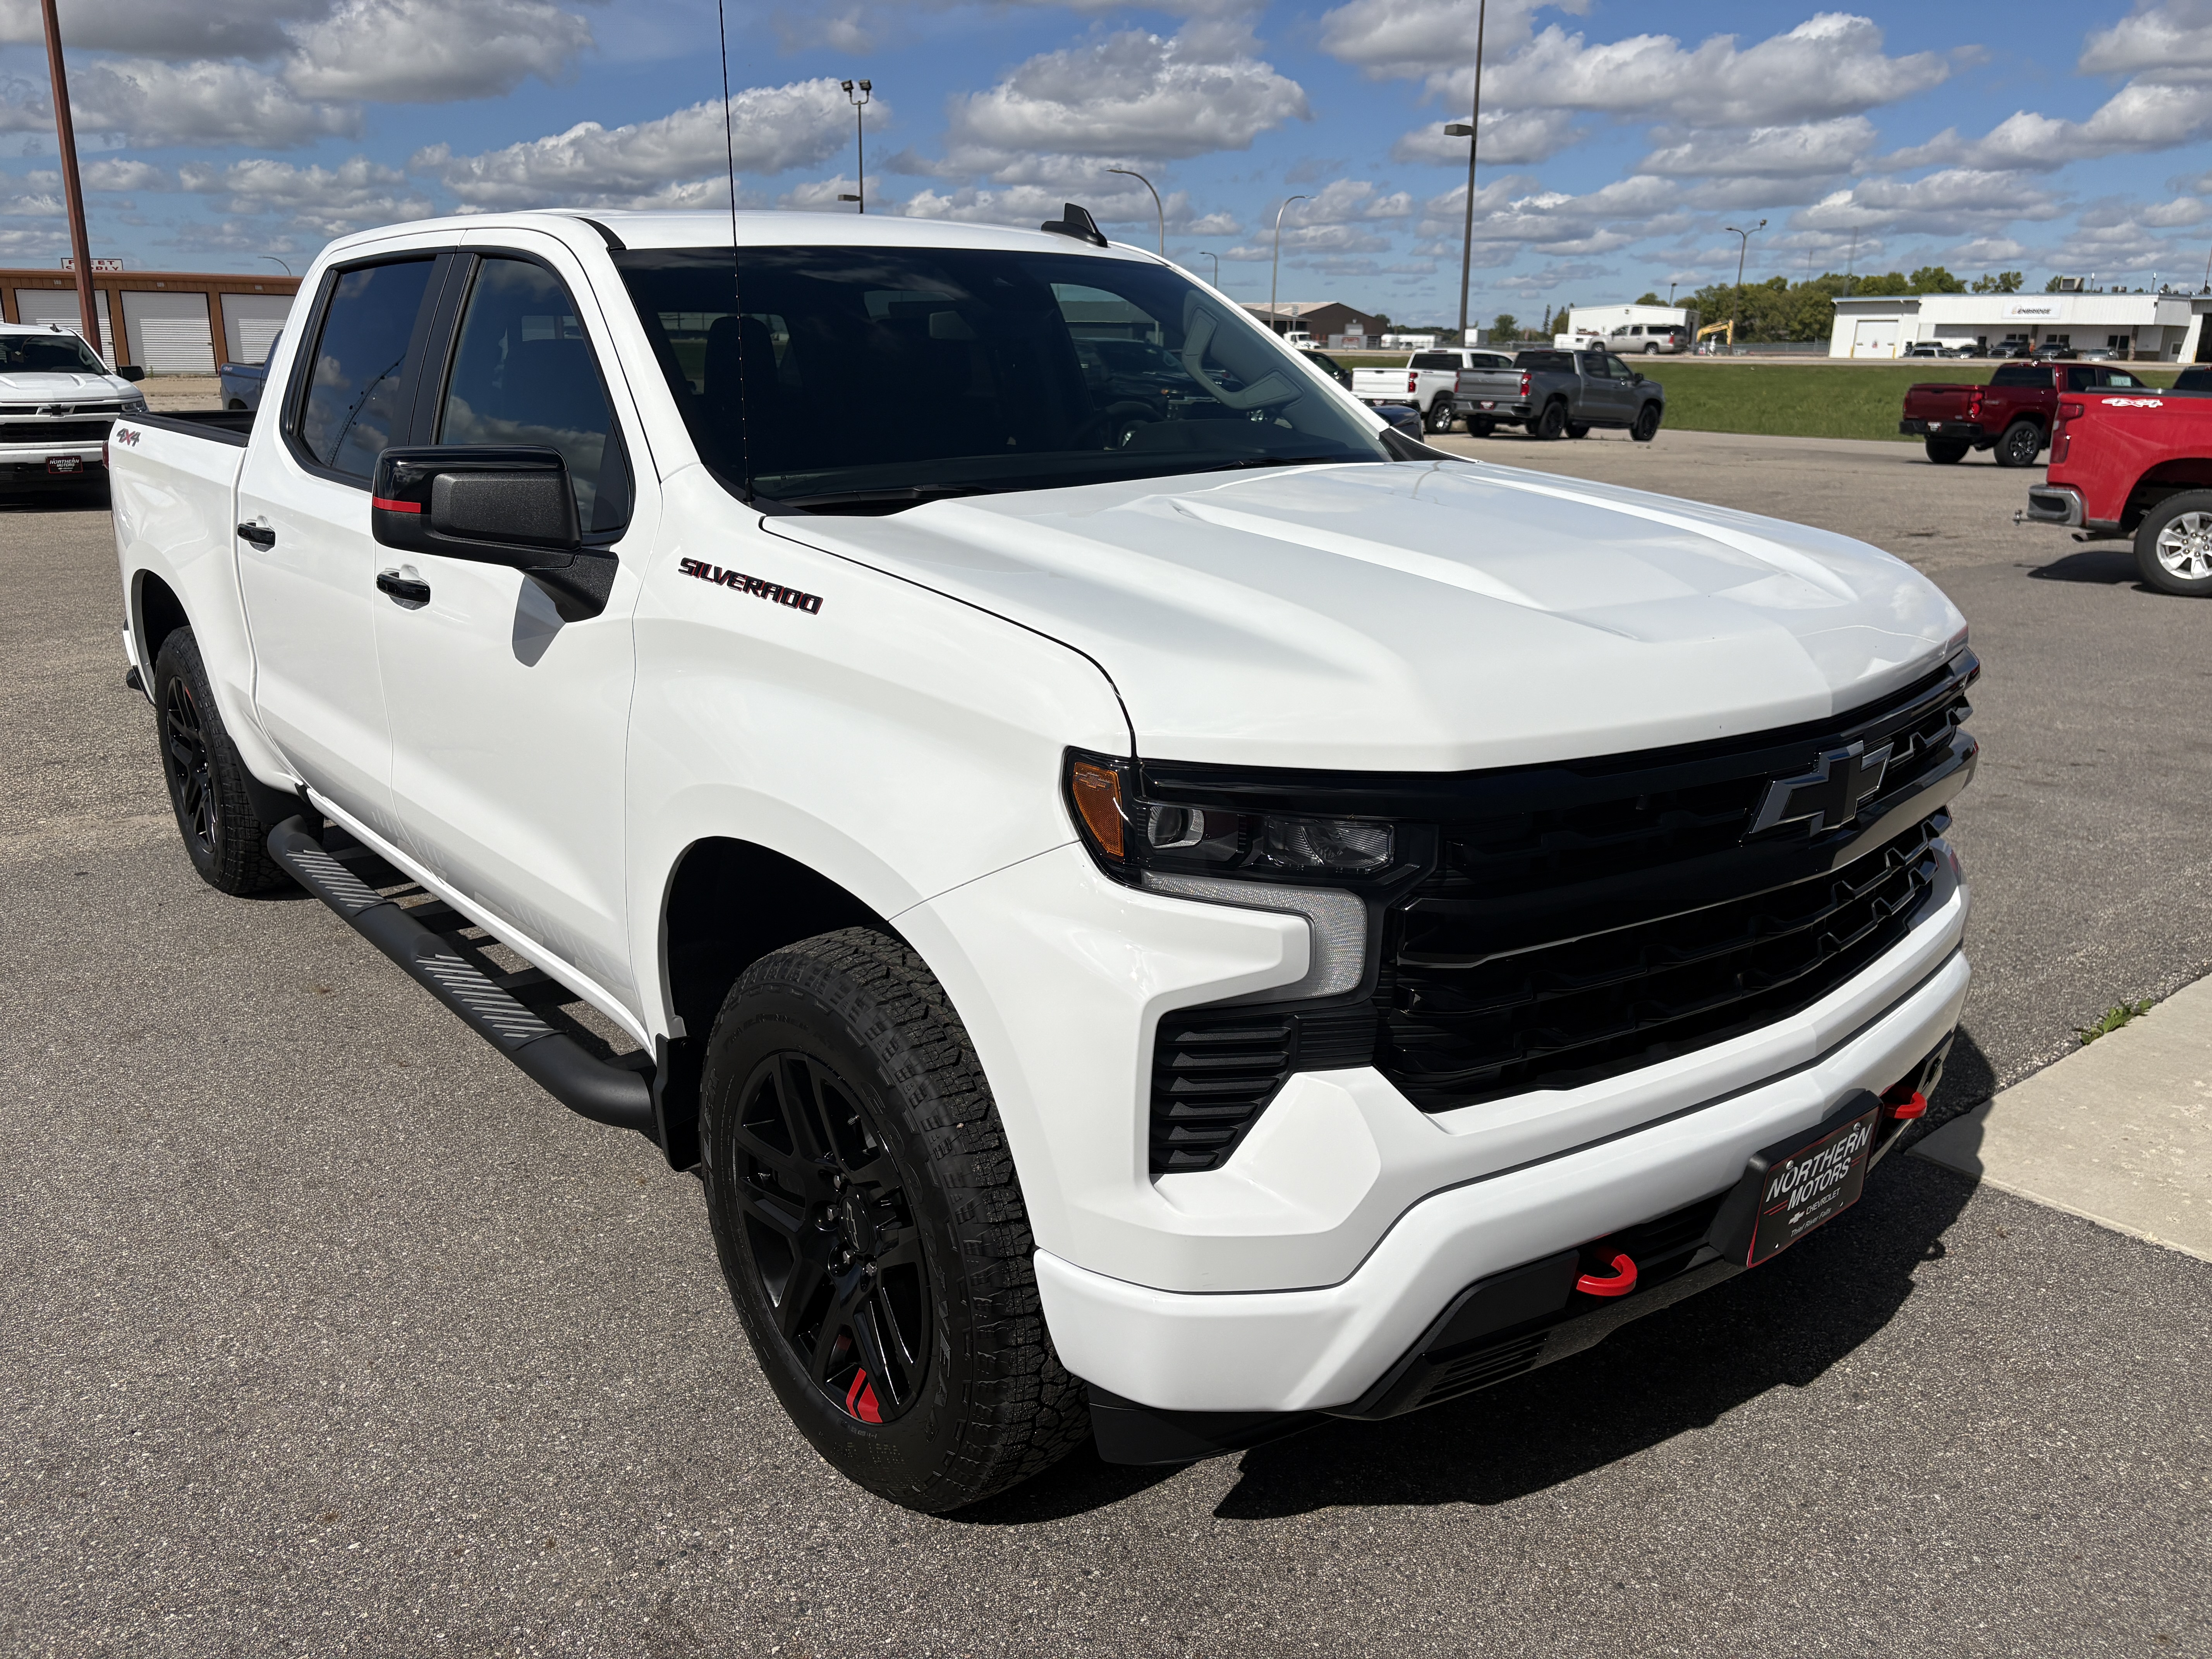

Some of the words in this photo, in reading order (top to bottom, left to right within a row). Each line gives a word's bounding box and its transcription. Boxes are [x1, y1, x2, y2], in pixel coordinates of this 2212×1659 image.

[2102, 398, 2163, 408] 4X4
[116, 428, 141, 447] 4X4
[678, 557, 823, 615] SILVERADO
[1765, 1123, 1872, 1202] NORTHERN
[1787, 1157, 1851, 1211] MOTORS
[1806, 1187, 1841, 1215] CHEVROLET
[1791, 1223, 1805, 1237] Thief
[1804, 1216, 1819, 1229] River
[1819, 1207, 1832, 1220] Falls
